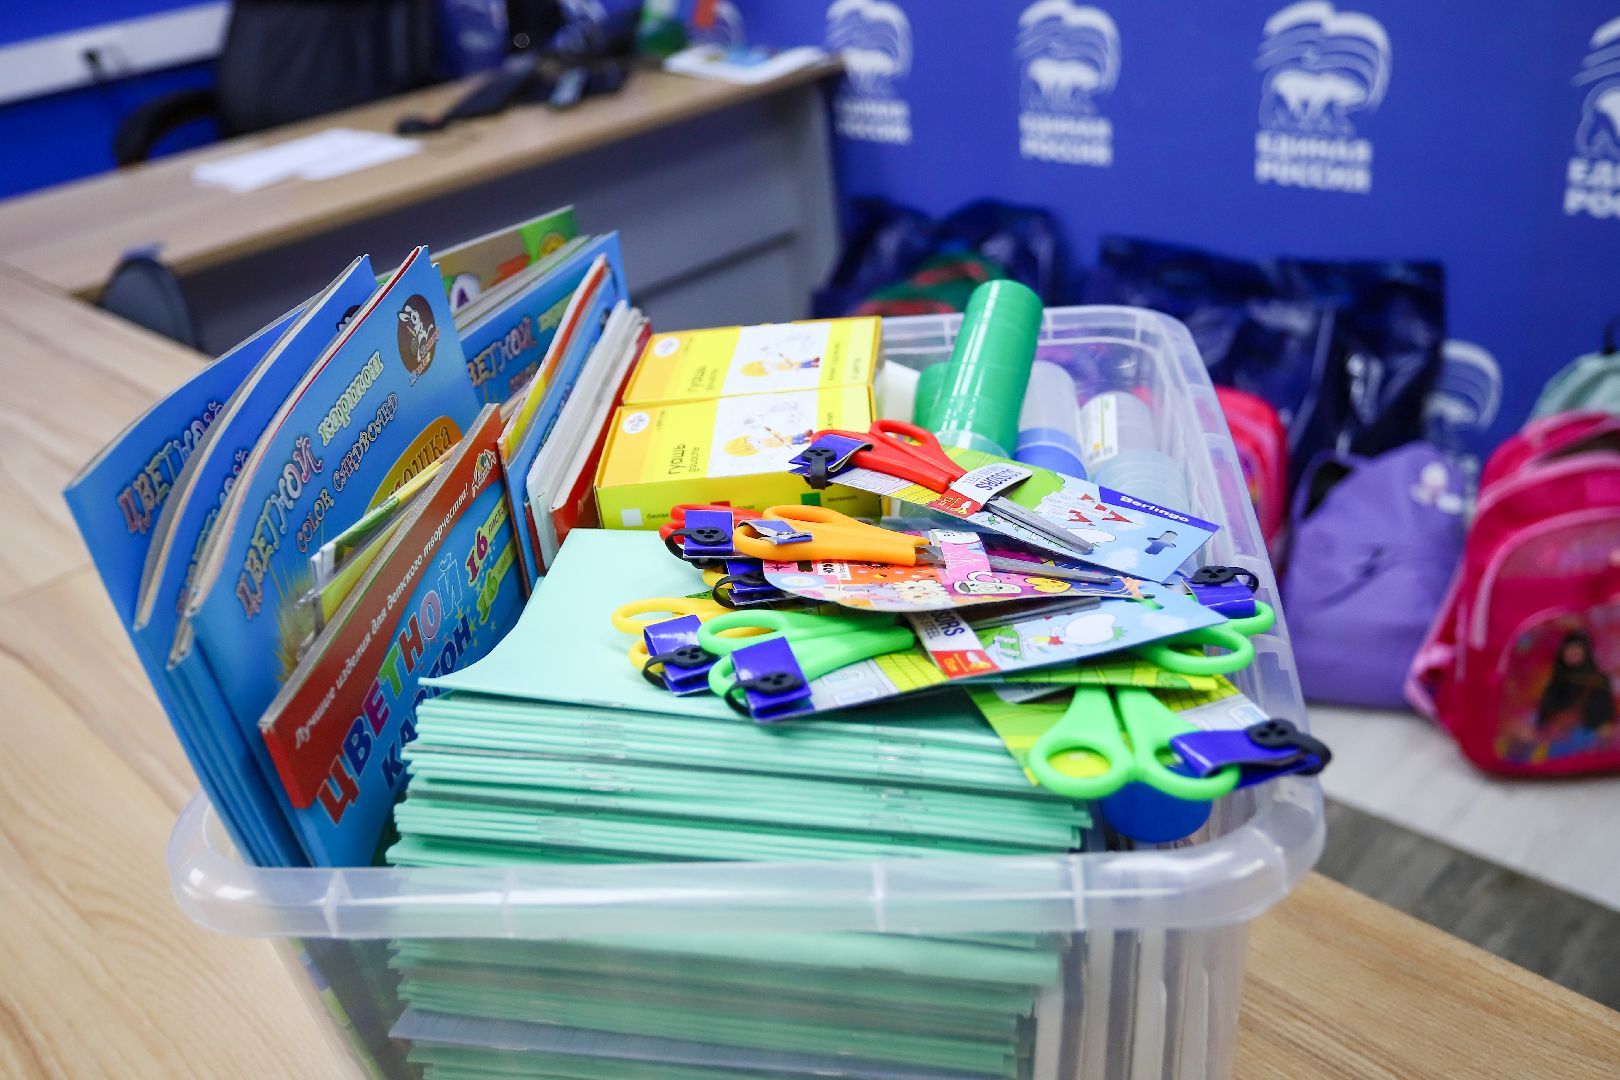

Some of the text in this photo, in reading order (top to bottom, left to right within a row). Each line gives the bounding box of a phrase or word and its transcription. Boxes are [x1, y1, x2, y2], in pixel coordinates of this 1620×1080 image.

[1256, 131, 1372, 162] ЕДИНАЯ
[1255, 159, 1371, 194] РОССИЯ
[1563, 188, 1620, 219] РО
[236, 437, 323, 619] ЦВЕТНОЙ
[1120, 495, 1189, 522] Berlingo
[465, 527, 489, 586] 16
[295, 687, 336, 749] Лучшие
[335, 634, 372, 690] изделия
[370, 610, 388, 636] для
[386, 557, 423, 612] детского
[317, 553, 463, 825] ЦВЕТНОЙ
